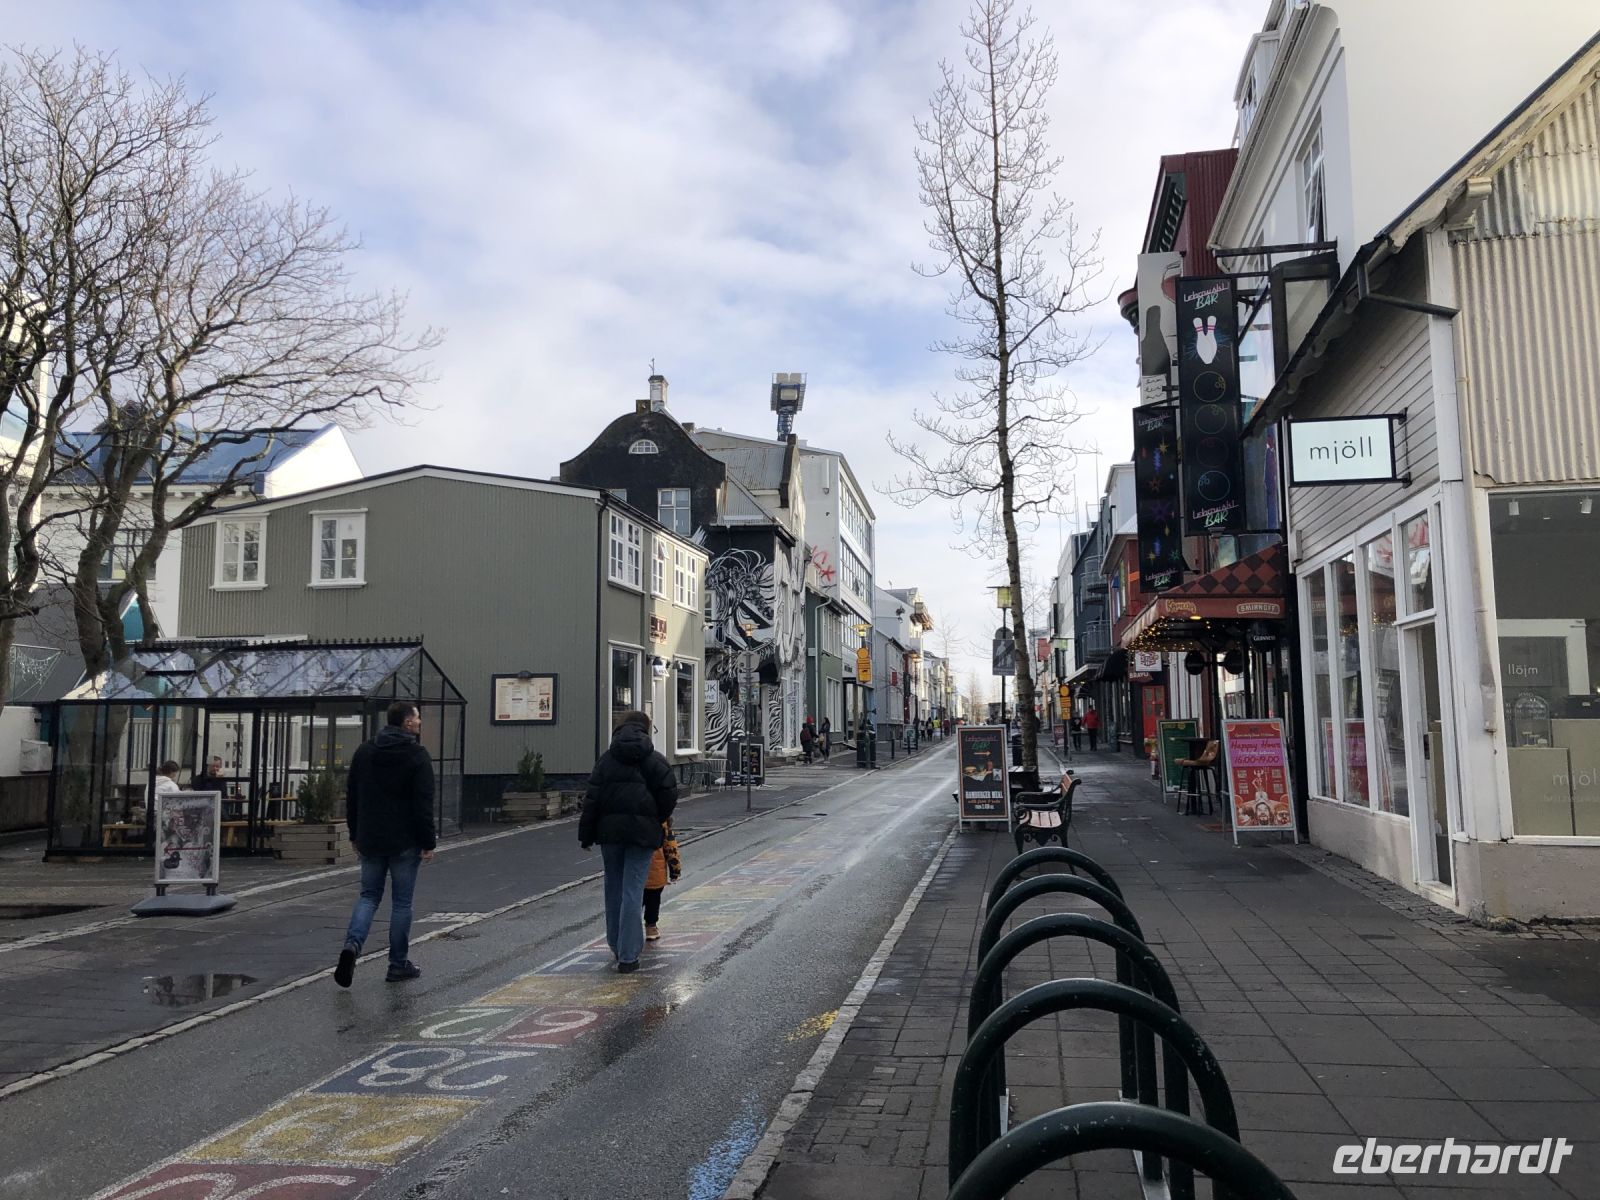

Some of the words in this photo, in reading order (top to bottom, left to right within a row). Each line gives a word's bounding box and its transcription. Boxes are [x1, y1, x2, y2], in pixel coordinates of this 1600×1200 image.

[1195, 292, 1219, 310] BAR
[1310, 436, 1373, 464] mjöll
[1204, 510, 1229, 528] BAR
[1154, 576, 1171, 587] BAR
[1240, 604, 1276, 612] SMIRNOFF
[357, 1046, 537, 1091] 28
